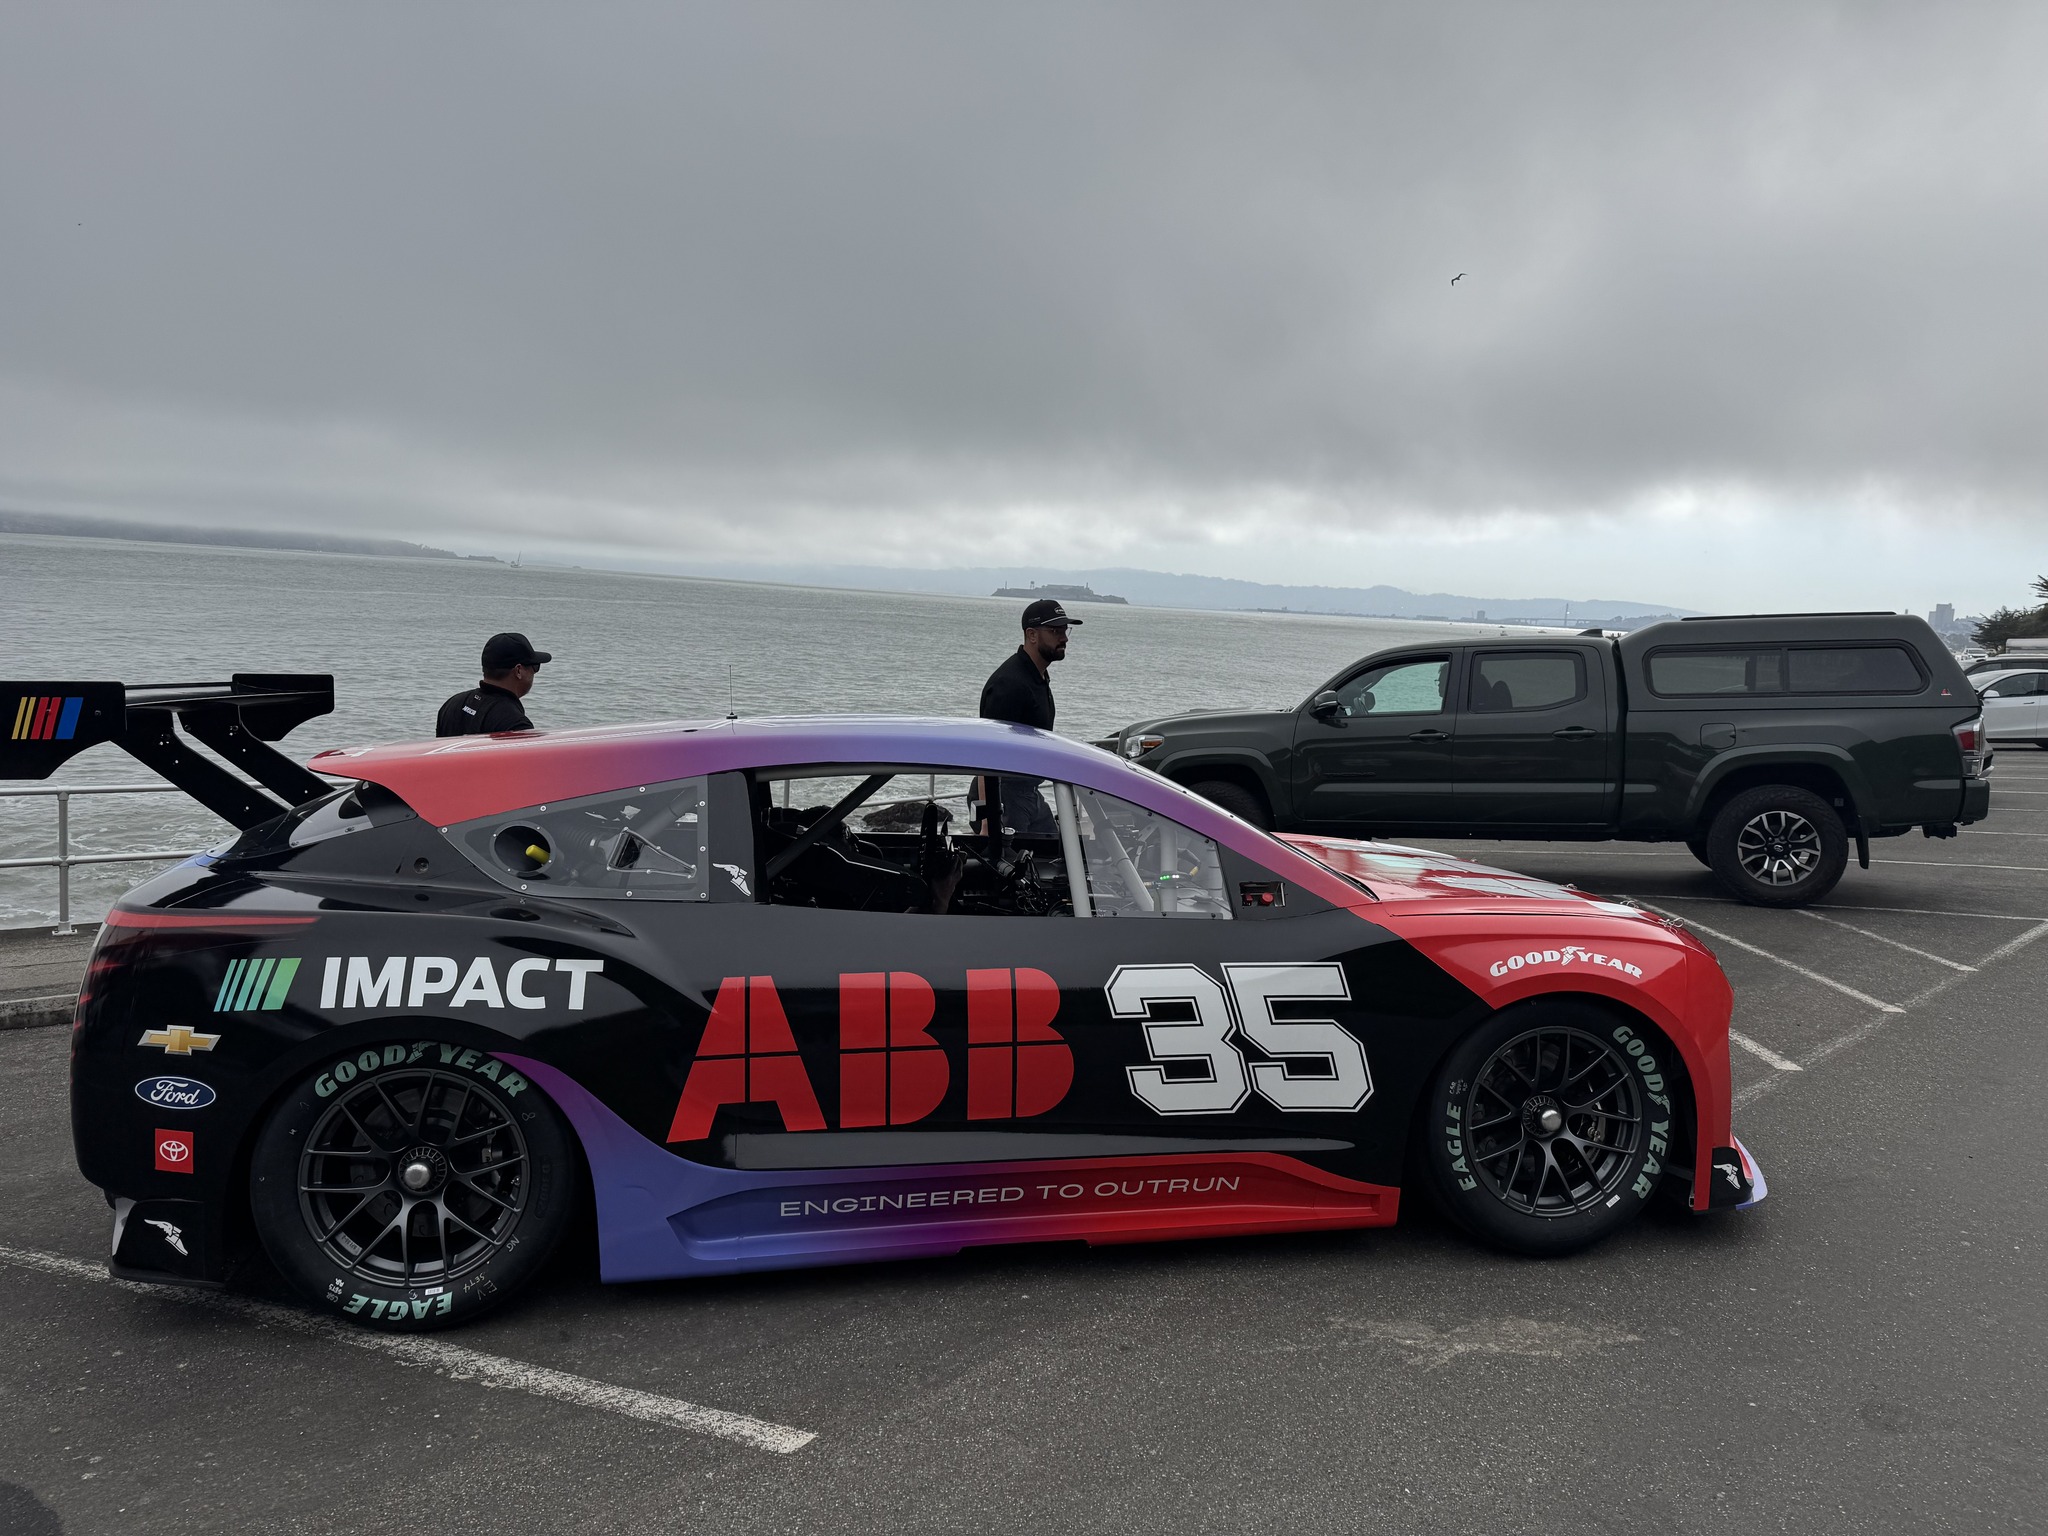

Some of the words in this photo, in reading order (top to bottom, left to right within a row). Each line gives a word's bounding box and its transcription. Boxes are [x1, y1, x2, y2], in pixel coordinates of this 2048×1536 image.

[320, 956, 604, 1010] IMPACT
[666, 967, 1074, 1143] ABB
[1104, 961, 1374, 1116] 35
[150, 1080, 200, 1107] Ford
[1446, 1101, 1479, 1191] EAGLE
[779, 1186, 1024, 1218] ENGINEERED
[1036, 1182, 1085, 1200] TO
[1093, 1175, 1241, 1198] OUTRUN
[343, 1291, 453, 1321] EAGLE
